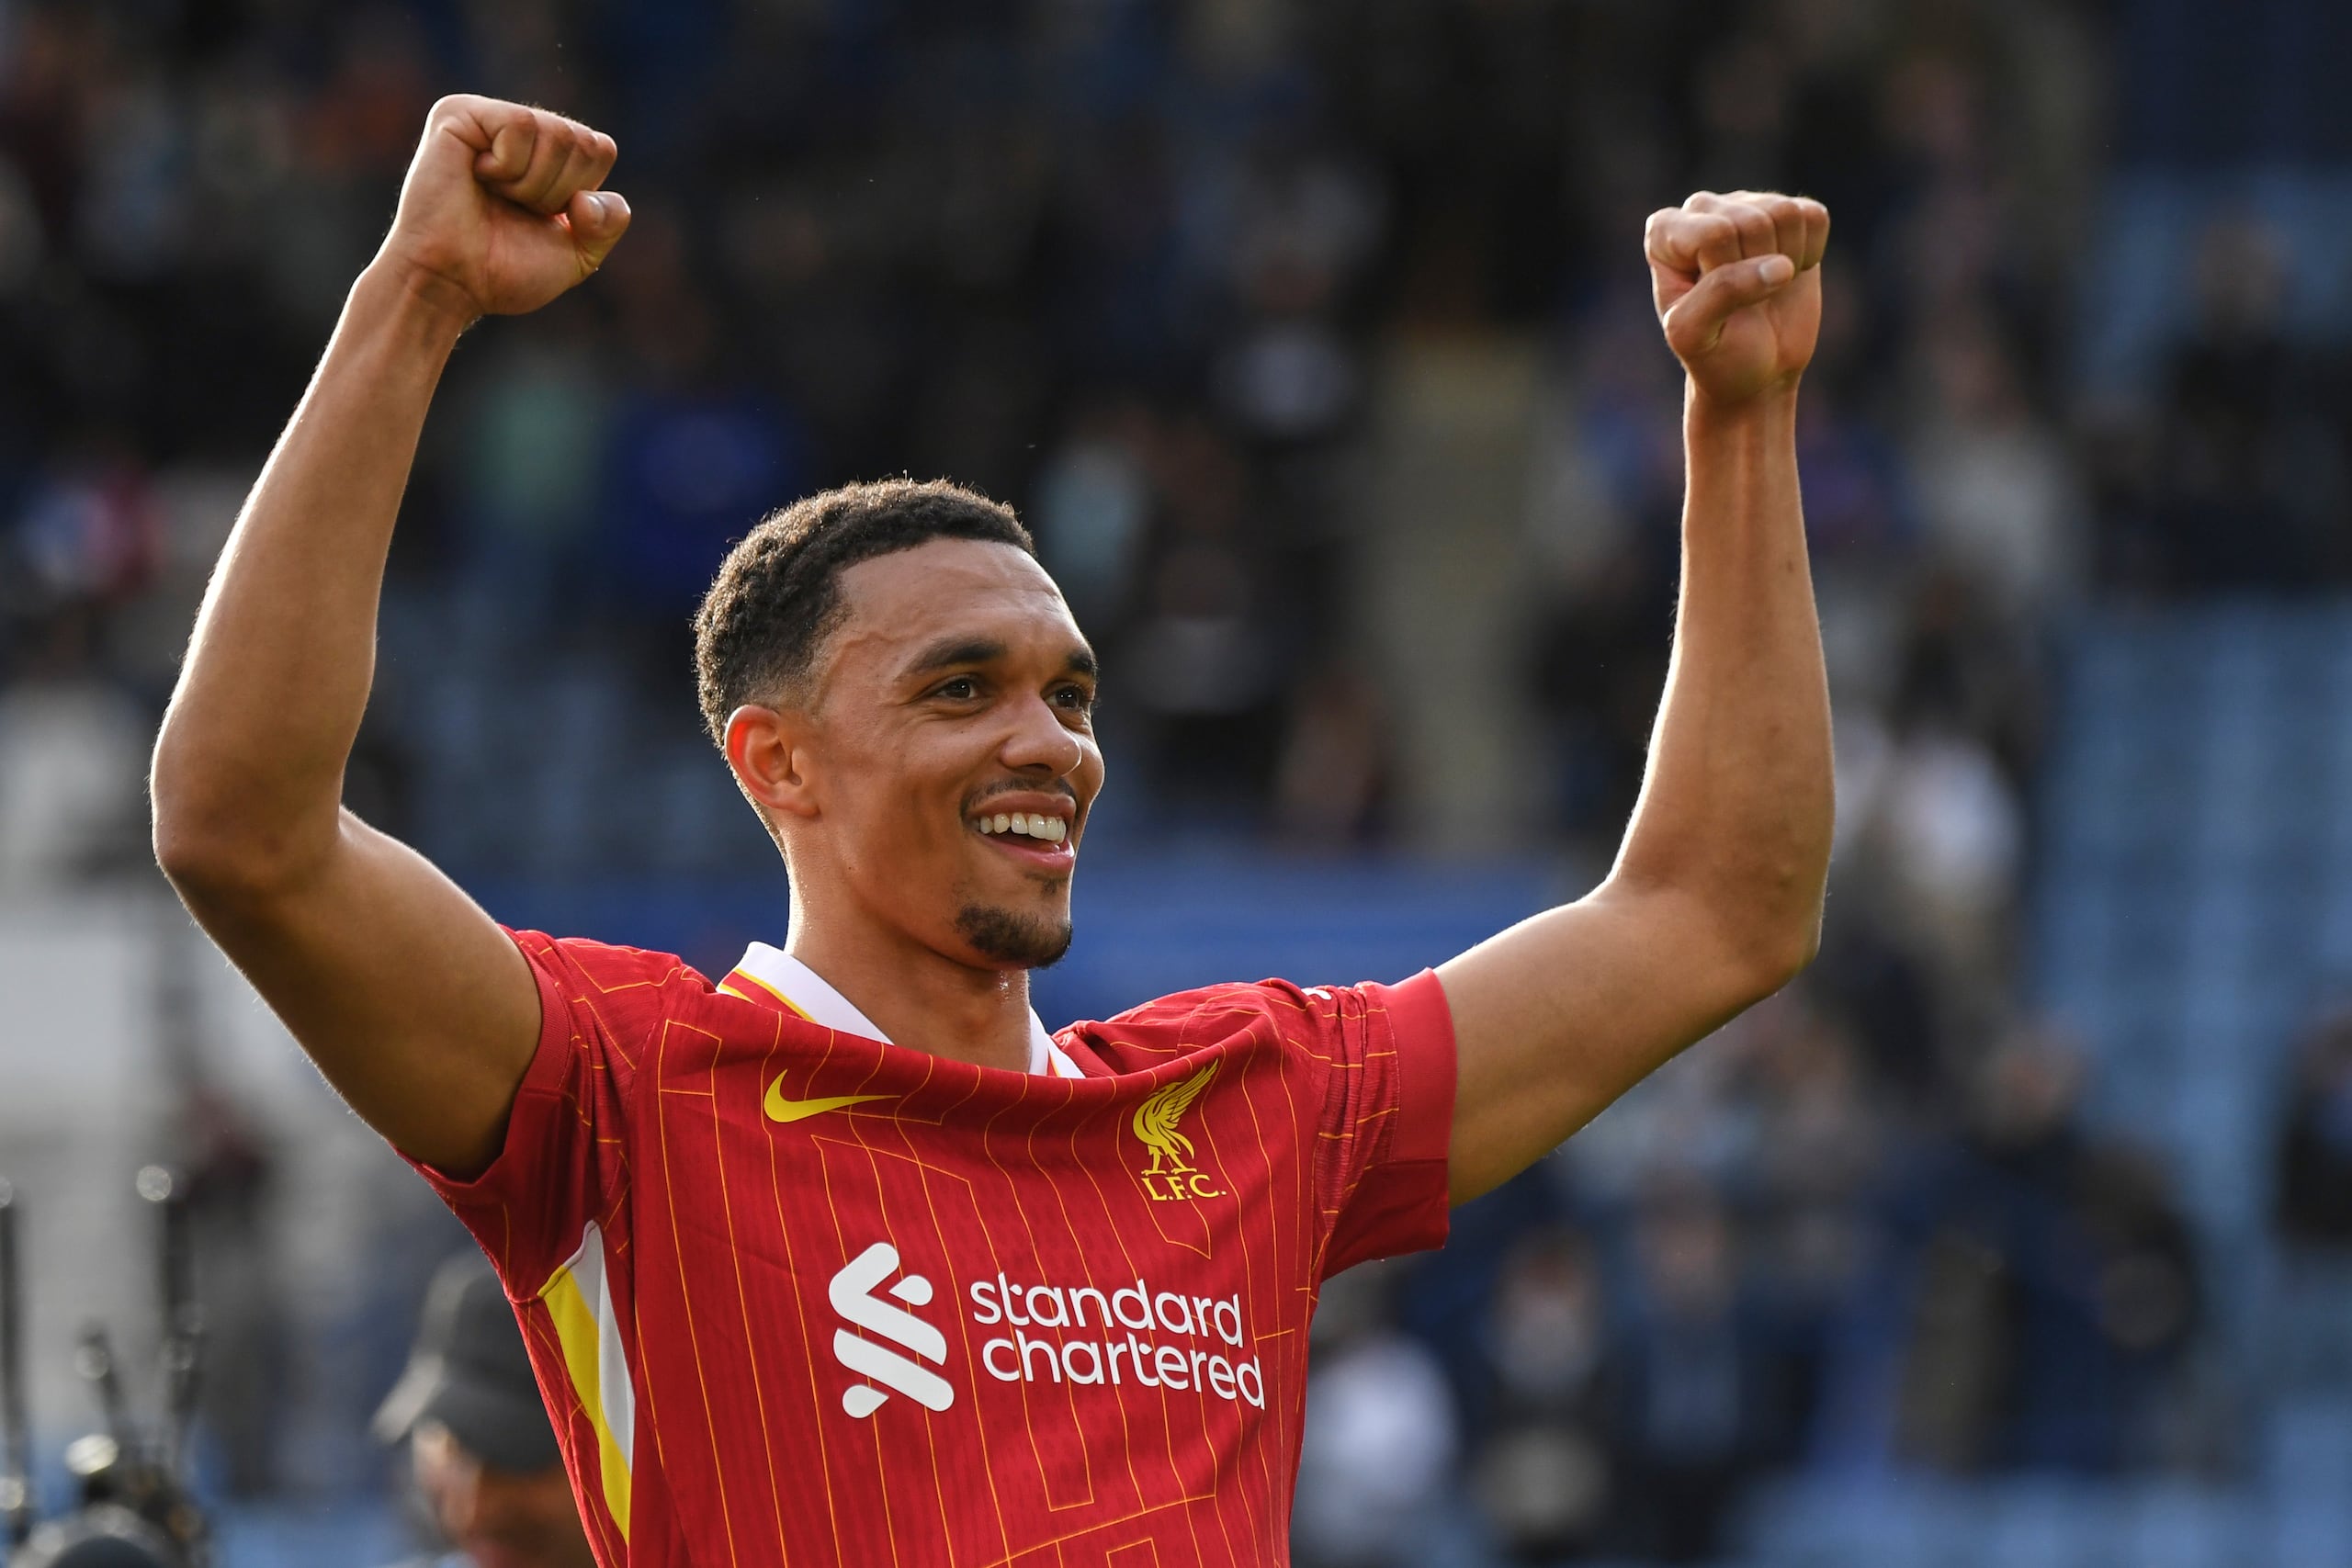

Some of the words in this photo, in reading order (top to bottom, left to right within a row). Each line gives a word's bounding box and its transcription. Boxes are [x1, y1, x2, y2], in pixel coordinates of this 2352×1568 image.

[1141, 1174, 1227, 1201] L.F.C.
[970, 1271, 1244, 1348] standard
[982, 1329, 1265, 1410] chartered
